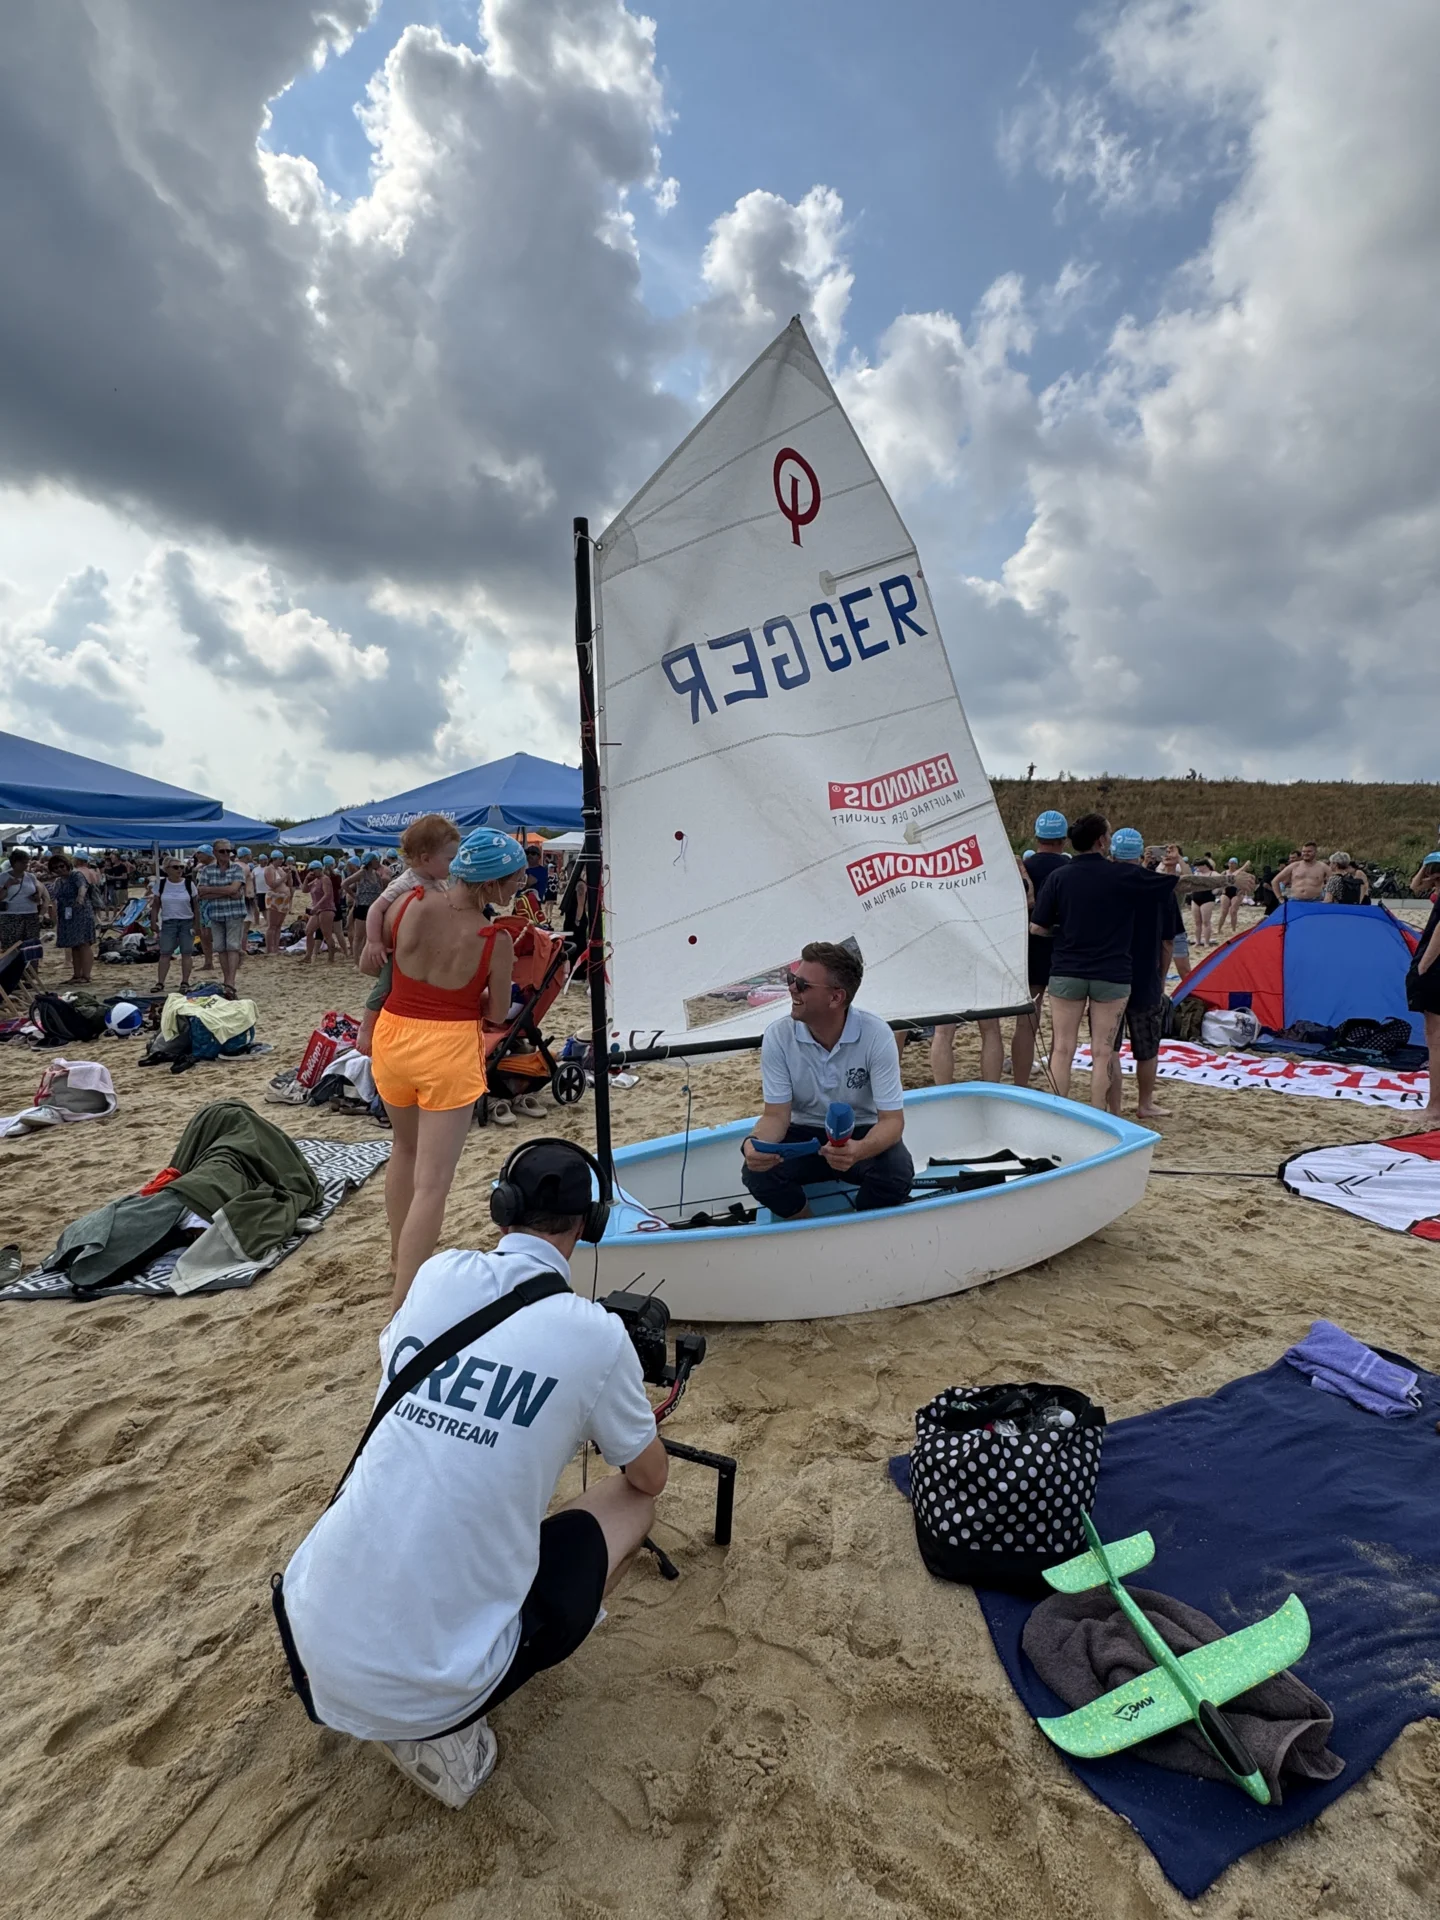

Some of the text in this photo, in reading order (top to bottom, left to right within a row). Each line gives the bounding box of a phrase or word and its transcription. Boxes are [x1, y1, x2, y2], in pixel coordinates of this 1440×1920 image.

[810, 574, 928, 672] GER
[861, 870, 988, 913] IM AUFTRAG DER ZUKUNFT
[387, 1335, 559, 1428] CREW
[394, 1400, 500, 1448] LIVESTREAM
